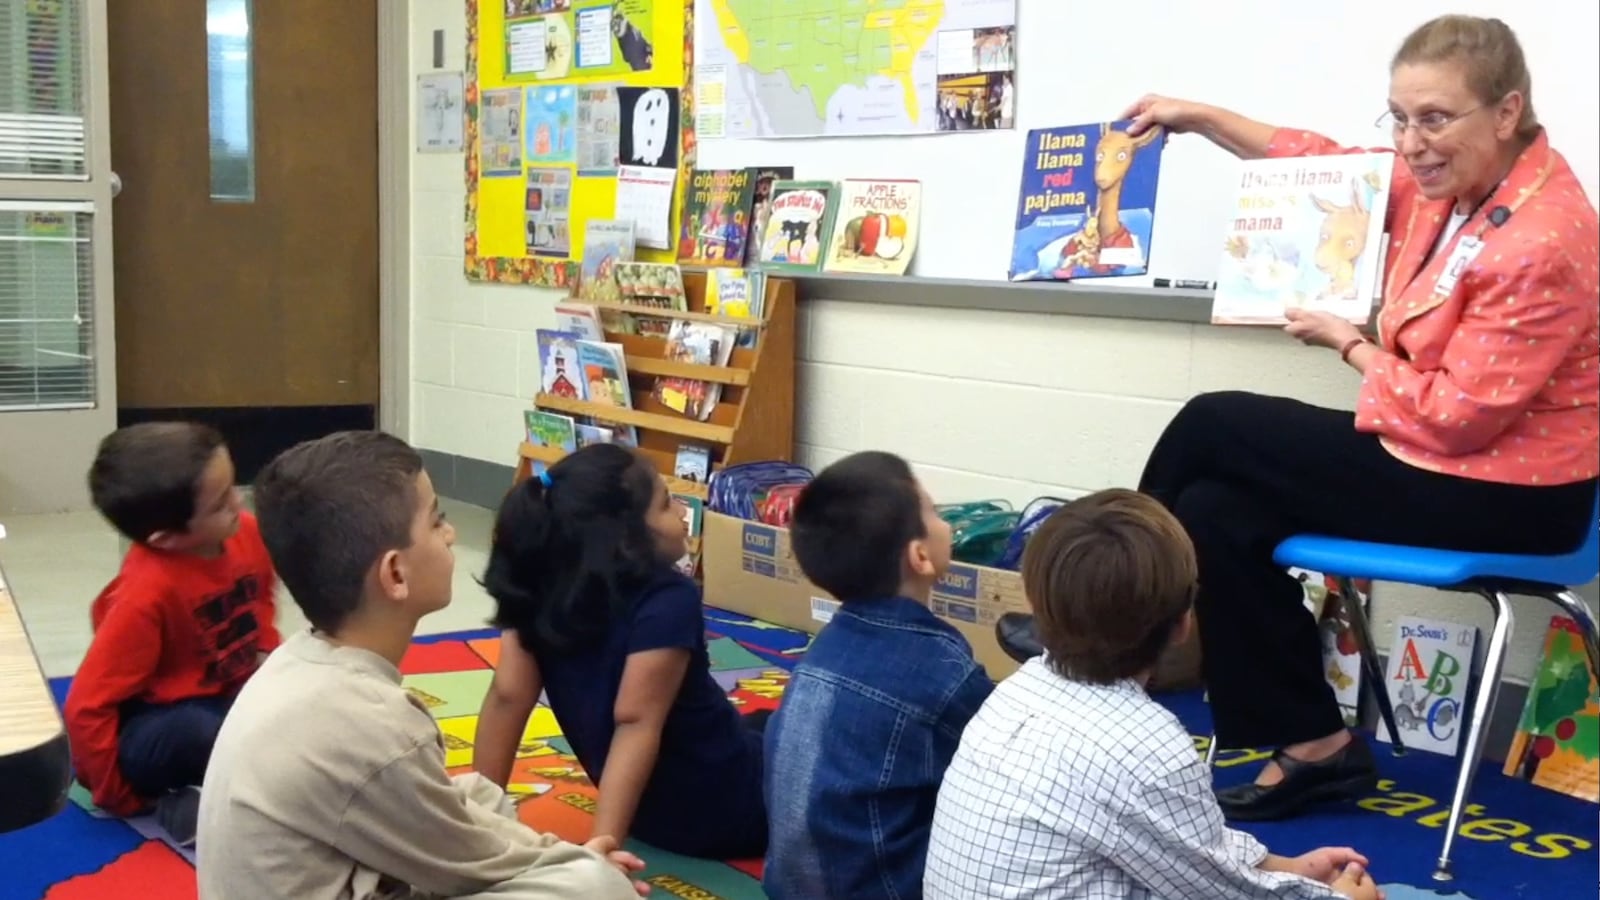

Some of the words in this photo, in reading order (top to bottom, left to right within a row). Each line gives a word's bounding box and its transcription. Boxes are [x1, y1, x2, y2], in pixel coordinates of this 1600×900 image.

[1039, 133, 1086, 151] llama
[1036, 152, 1083, 170] llama
[694, 171, 748, 192] alphabet
[1042, 168, 1073, 188] red
[1295, 168, 1344, 187] llama
[694, 190, 741, 206] mystery
[866, 184, 897, 197] APPLE
[853, 196, 908, 210] FRACTIONS
[1024, 190, 1086, 216] pajama
[1239, 192, 1297, 210] misss
[1234, 217, 1284, 232] mama
[745, 532, 770, 548] COBY
[1401, 626, 1416, 639] Dr.
[1394, 638, 1428, 681] A
[1422, 649, 1460, 697] B
[1426, 697, 1461, 742] C
